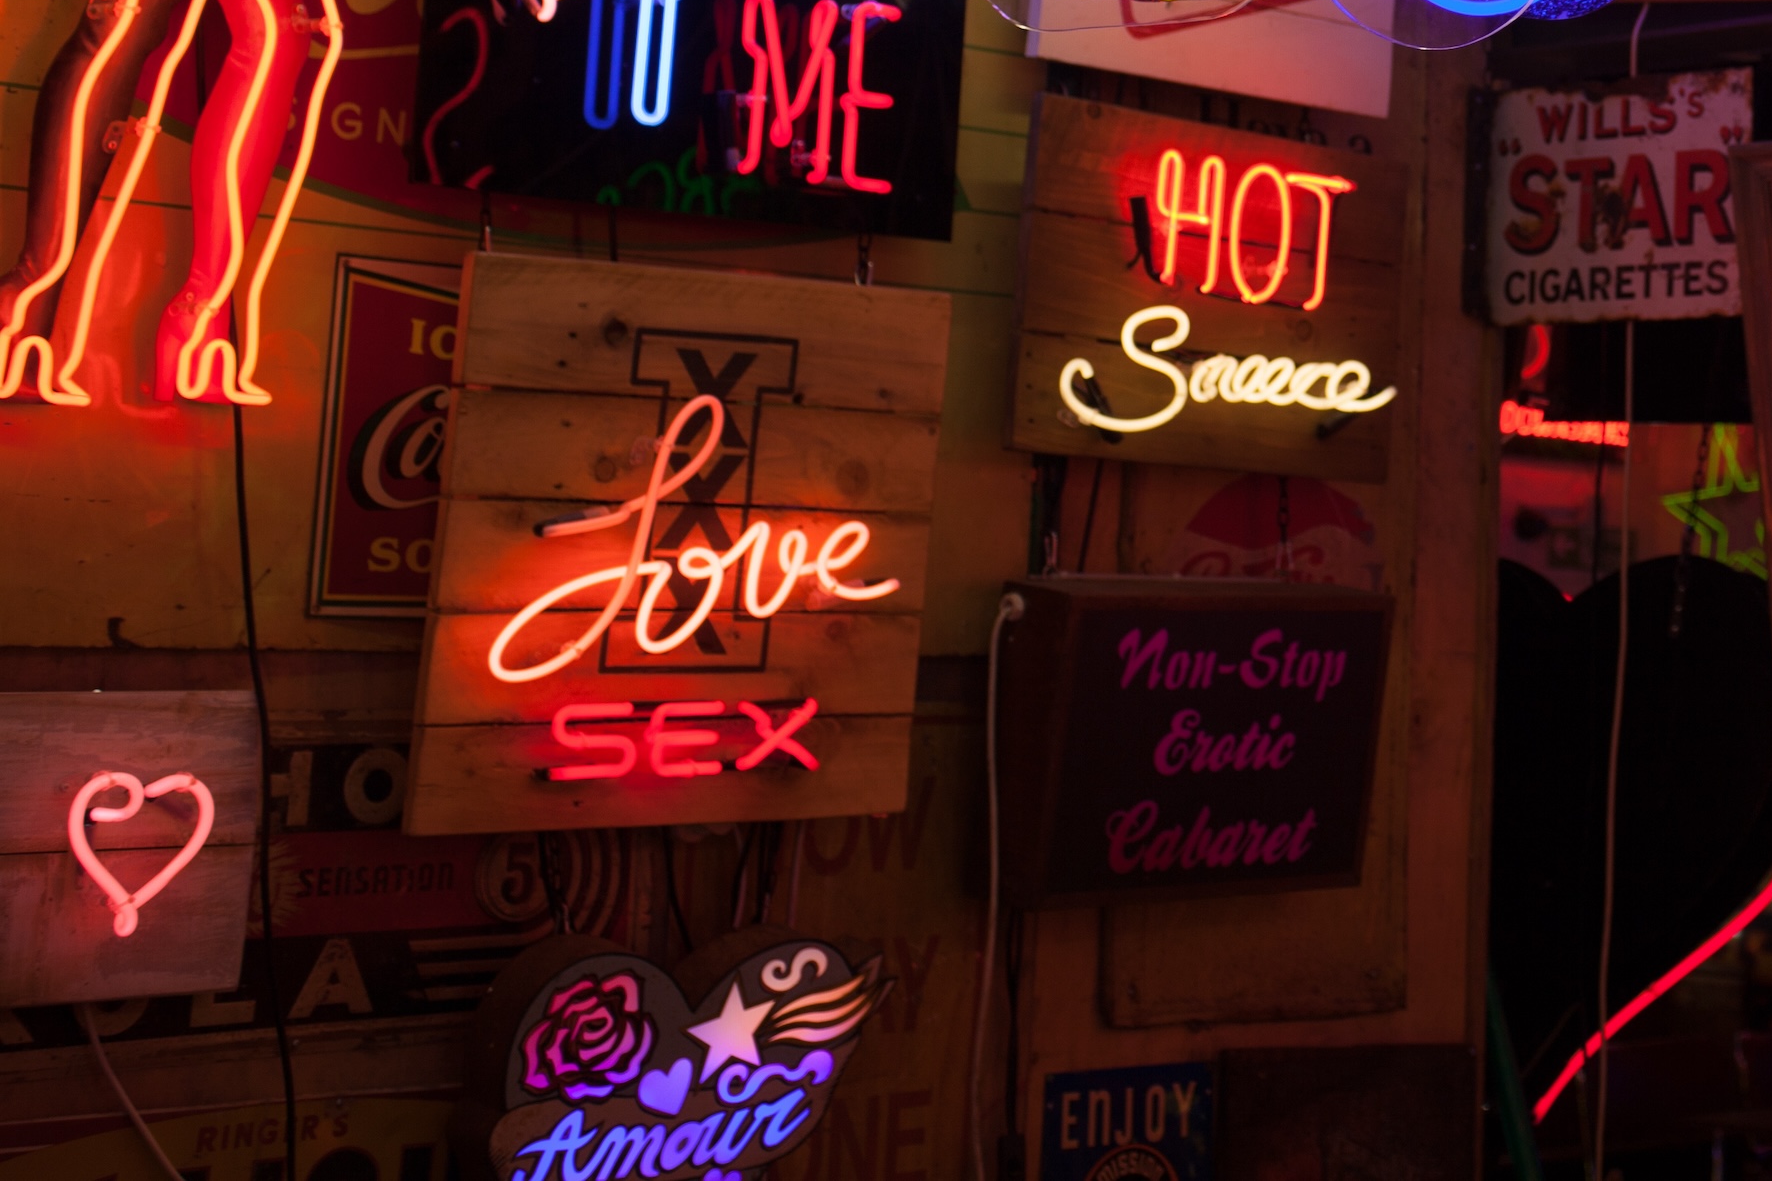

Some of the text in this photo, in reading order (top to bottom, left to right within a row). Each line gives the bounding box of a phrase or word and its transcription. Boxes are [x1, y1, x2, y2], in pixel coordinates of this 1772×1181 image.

[1156, 147, 1357, 312] HOT
[1504, 260, 1730, 305] CIGARETTES
[488, 392, 902, 684] Love
[1117, 626, 1349, 703] Non-Stop
[547, 696, 821, 783] SEX
[1153, 707, 1297, 776] Erotic
[501, 841, 536, 906] 5
[1105, 799, 1319, 874] Cabaret
[296, 861, 456, 900] SENSATION
[511, 1086, 813, 1181] Amour
[1060, 1080, 1198, 1151] ENJOY
